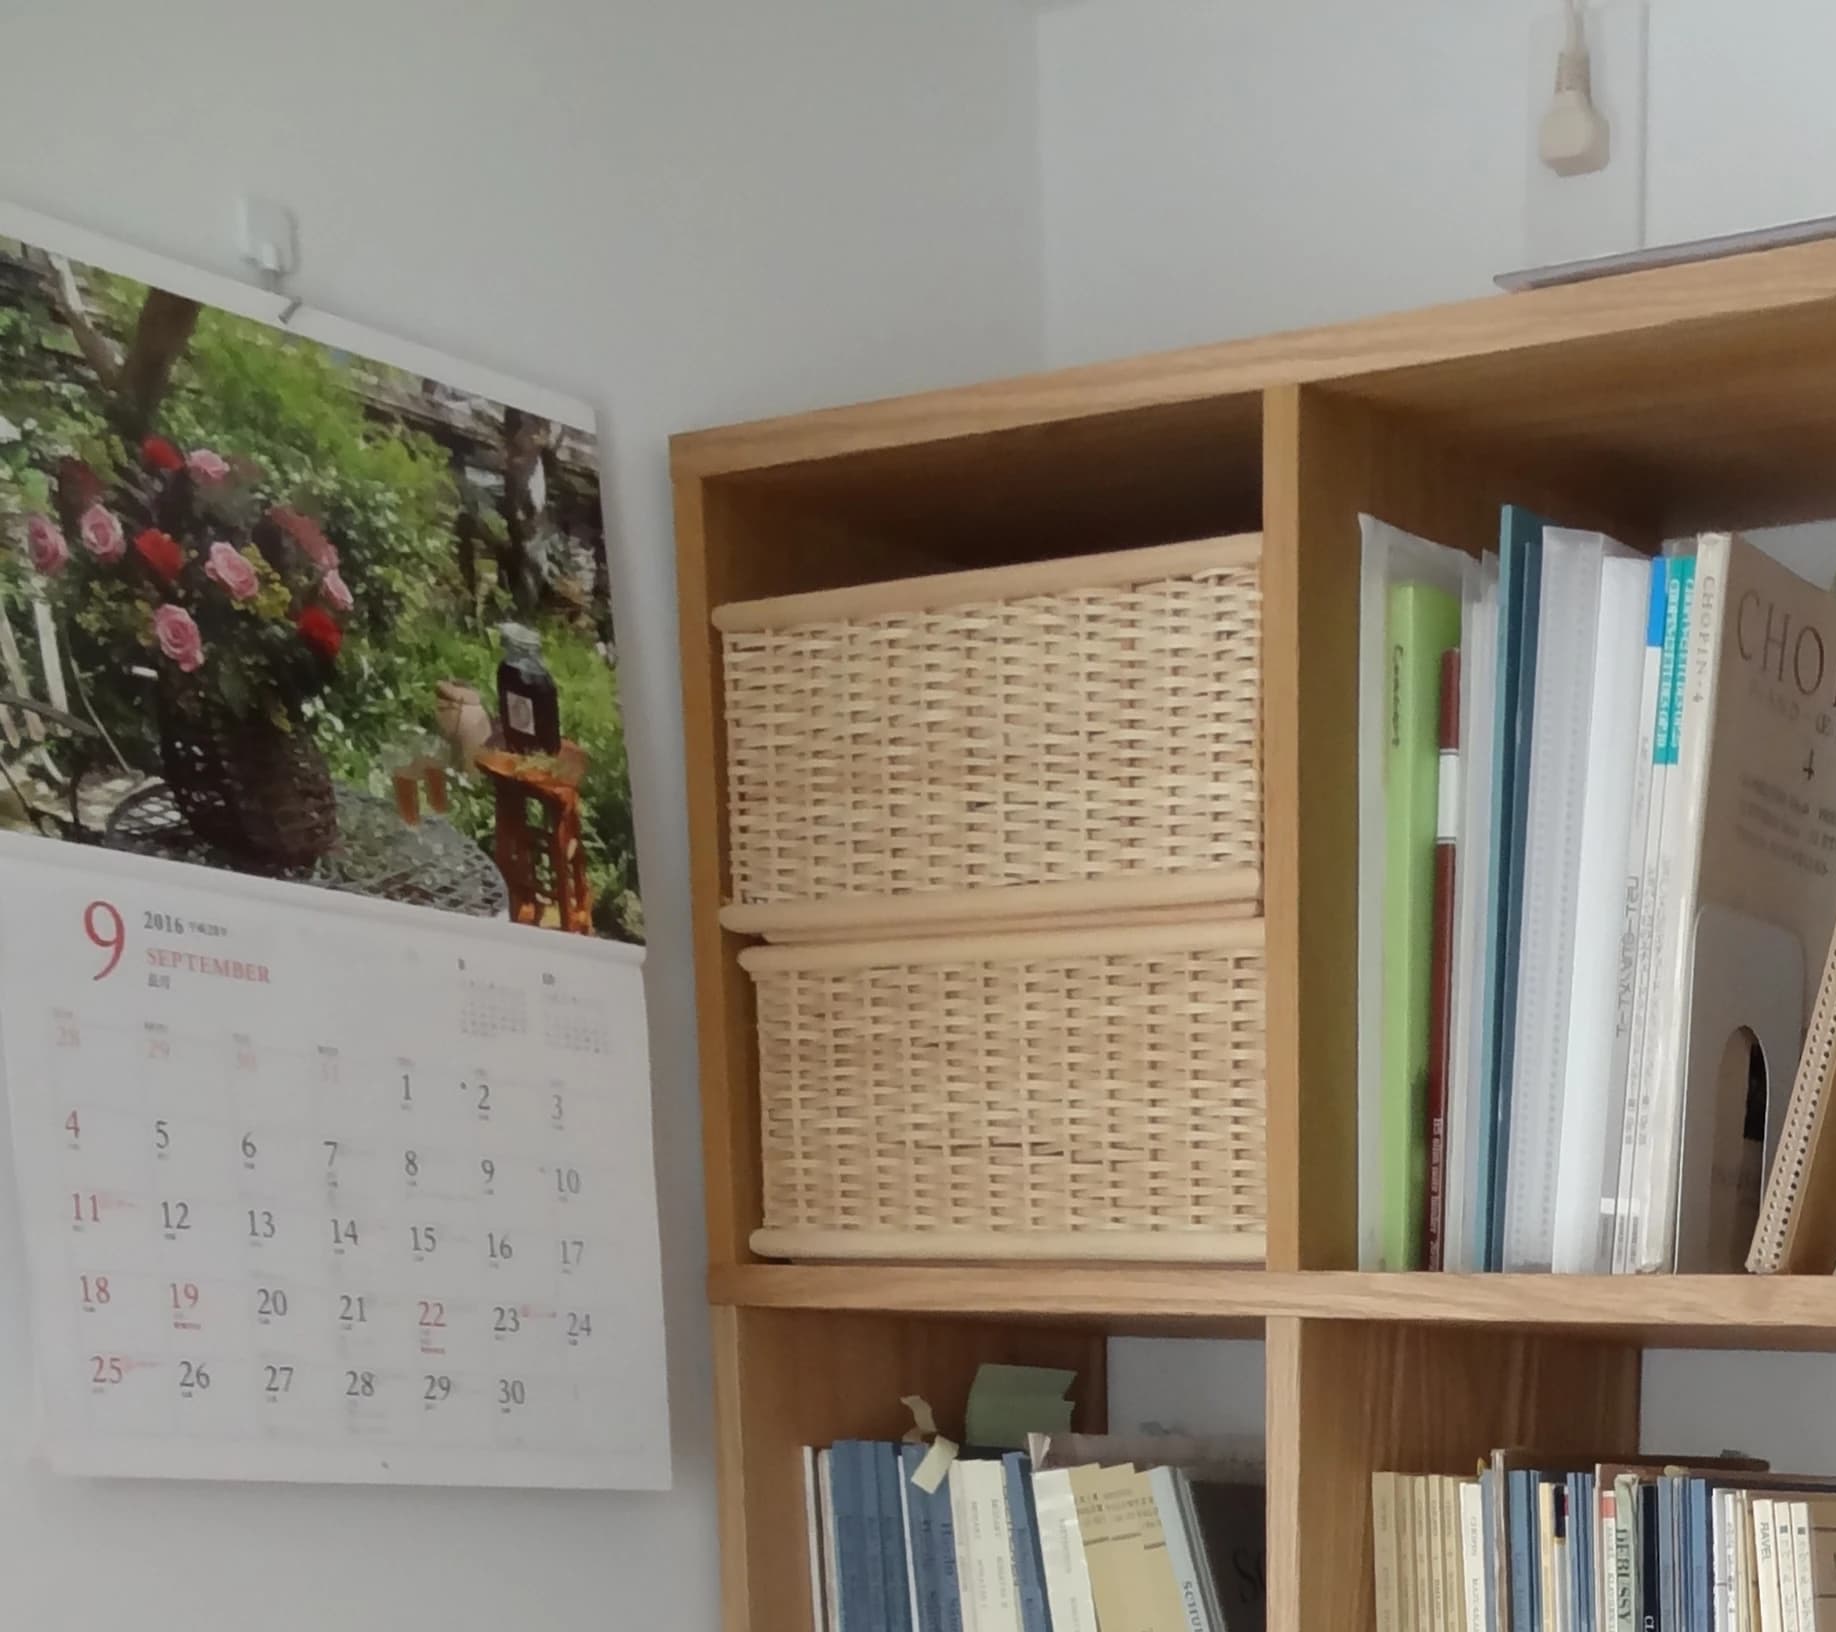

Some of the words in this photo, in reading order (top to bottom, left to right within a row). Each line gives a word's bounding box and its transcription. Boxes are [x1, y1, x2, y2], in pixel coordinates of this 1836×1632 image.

[84, 901, 124, 981] 9
[144, 911, 184, 934] 2016
[146, 948, 271, 983] SEPTEMBER
[402, 1074, 412, 1100] 1
[478, 1085, 490, 1110] 2
[551, 1095, 563, 1120] 3
[65, 1110, 80, 1138] 4
[155, 1120, 169, 1149] 5
[241, 1131, 256, 1158] 6
[324, 1141, 338, 1166] 7
[404, 1151, 418, 1176] 8
[481, 1160, 494, 1183] 9
[555, 1168, 581, 1193] 10
[72, 1193, 100, 1222] 11
[161, 1201, 191, 1230] 12
[248, 1210, 276, 1238] 13
[331, 1219, 359, 1246] 14
[410, 1226, 437, 1252] 15
[488, 1232, 512, 1259] 16
[561, 1240, 584, 1265] 17
[80, 1275, 111, 1304] 18
[170, 1283, 199, 1309] 19
[257, 1289, 288, 1316] 20
[339, 1295, 367, 1322] 21
[418, 1301, 447, 1327] 22
[493, 1307, 520, 1332] 23
[567, 1312, 592, 1337] 24
[90, 1356, 123, 1384] 25
[178, 1360, 210, 1389] 26
[264, 1365, 294, 1392] 27
[346, 1370, 375, 1397] 28
[424, 1375, 451, 1401] 29
[498, 1379, 525, 1405] 30
[1760, 1522, 1771, 1560] RAVEL
[1616, 1528, 1631, 1628] DEBUSSY
